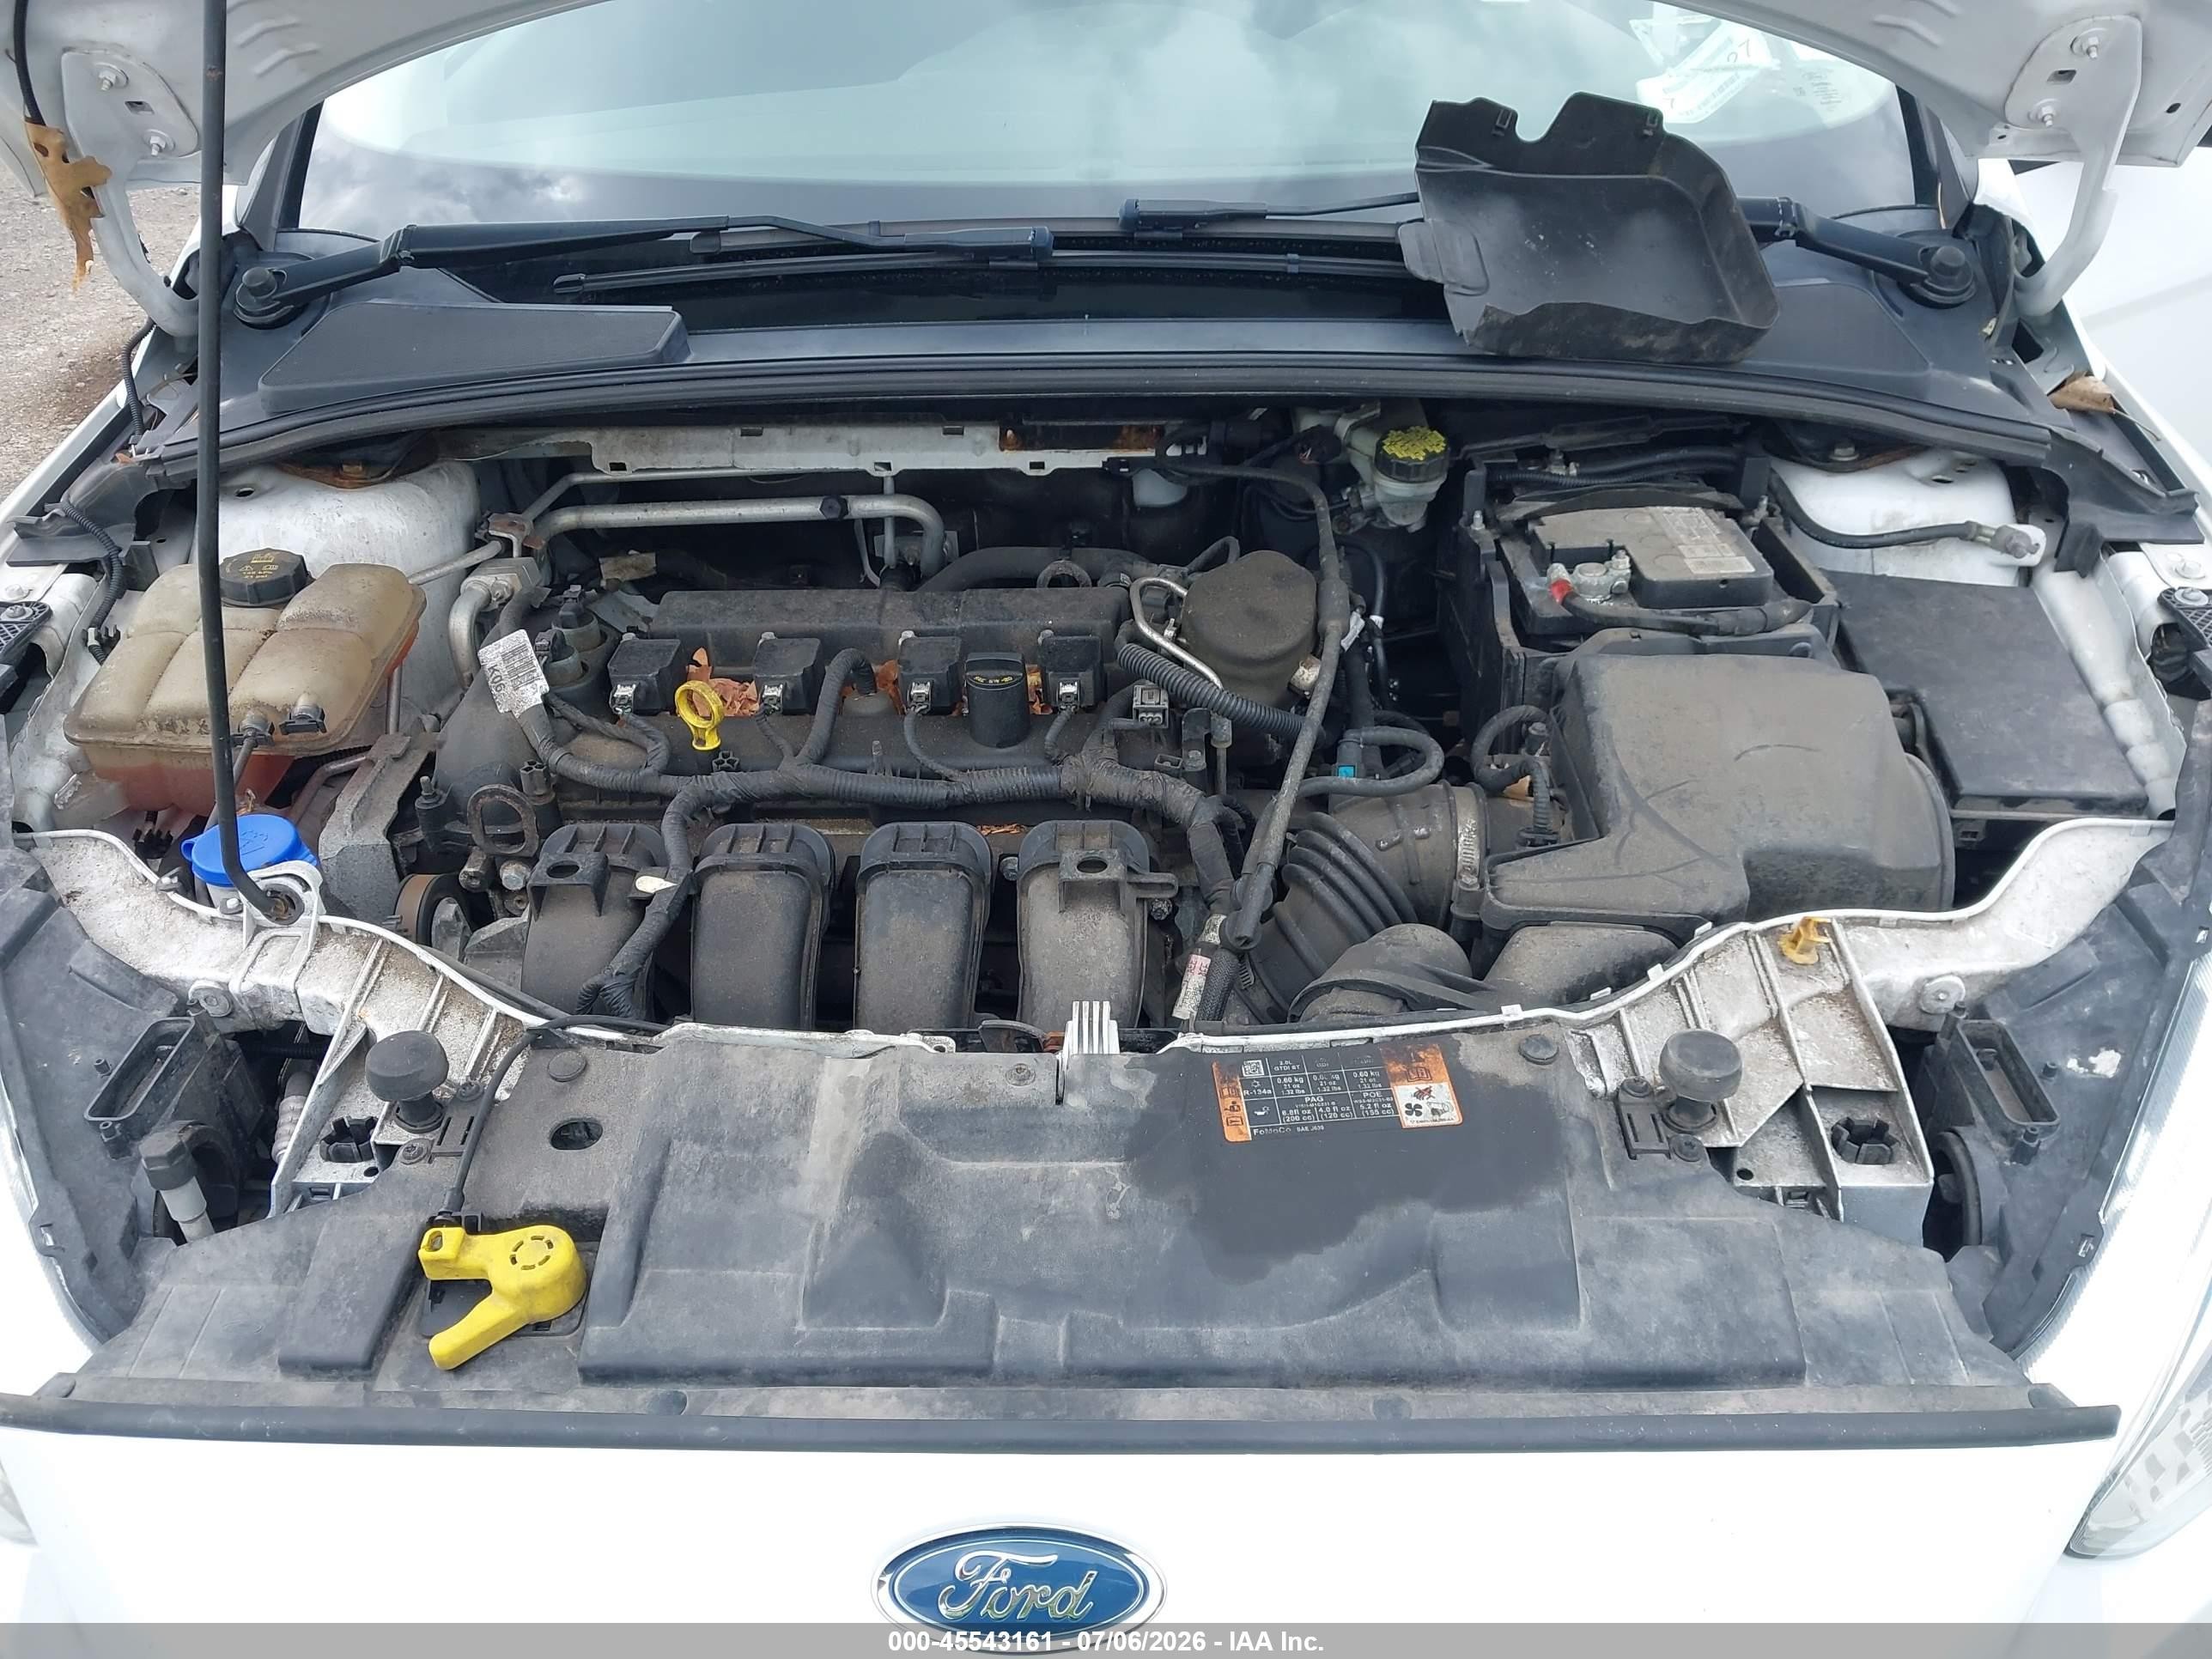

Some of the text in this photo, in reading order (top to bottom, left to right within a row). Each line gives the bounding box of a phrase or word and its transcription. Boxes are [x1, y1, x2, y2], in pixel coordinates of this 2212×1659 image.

[1321, 1112, 1338, 1121] (120
[1362, 1109, 1380, 1117] (155
[1253, 1126, 1291, 1136] FoMoCo
[938, 1549, 1099, 1620] Ford
